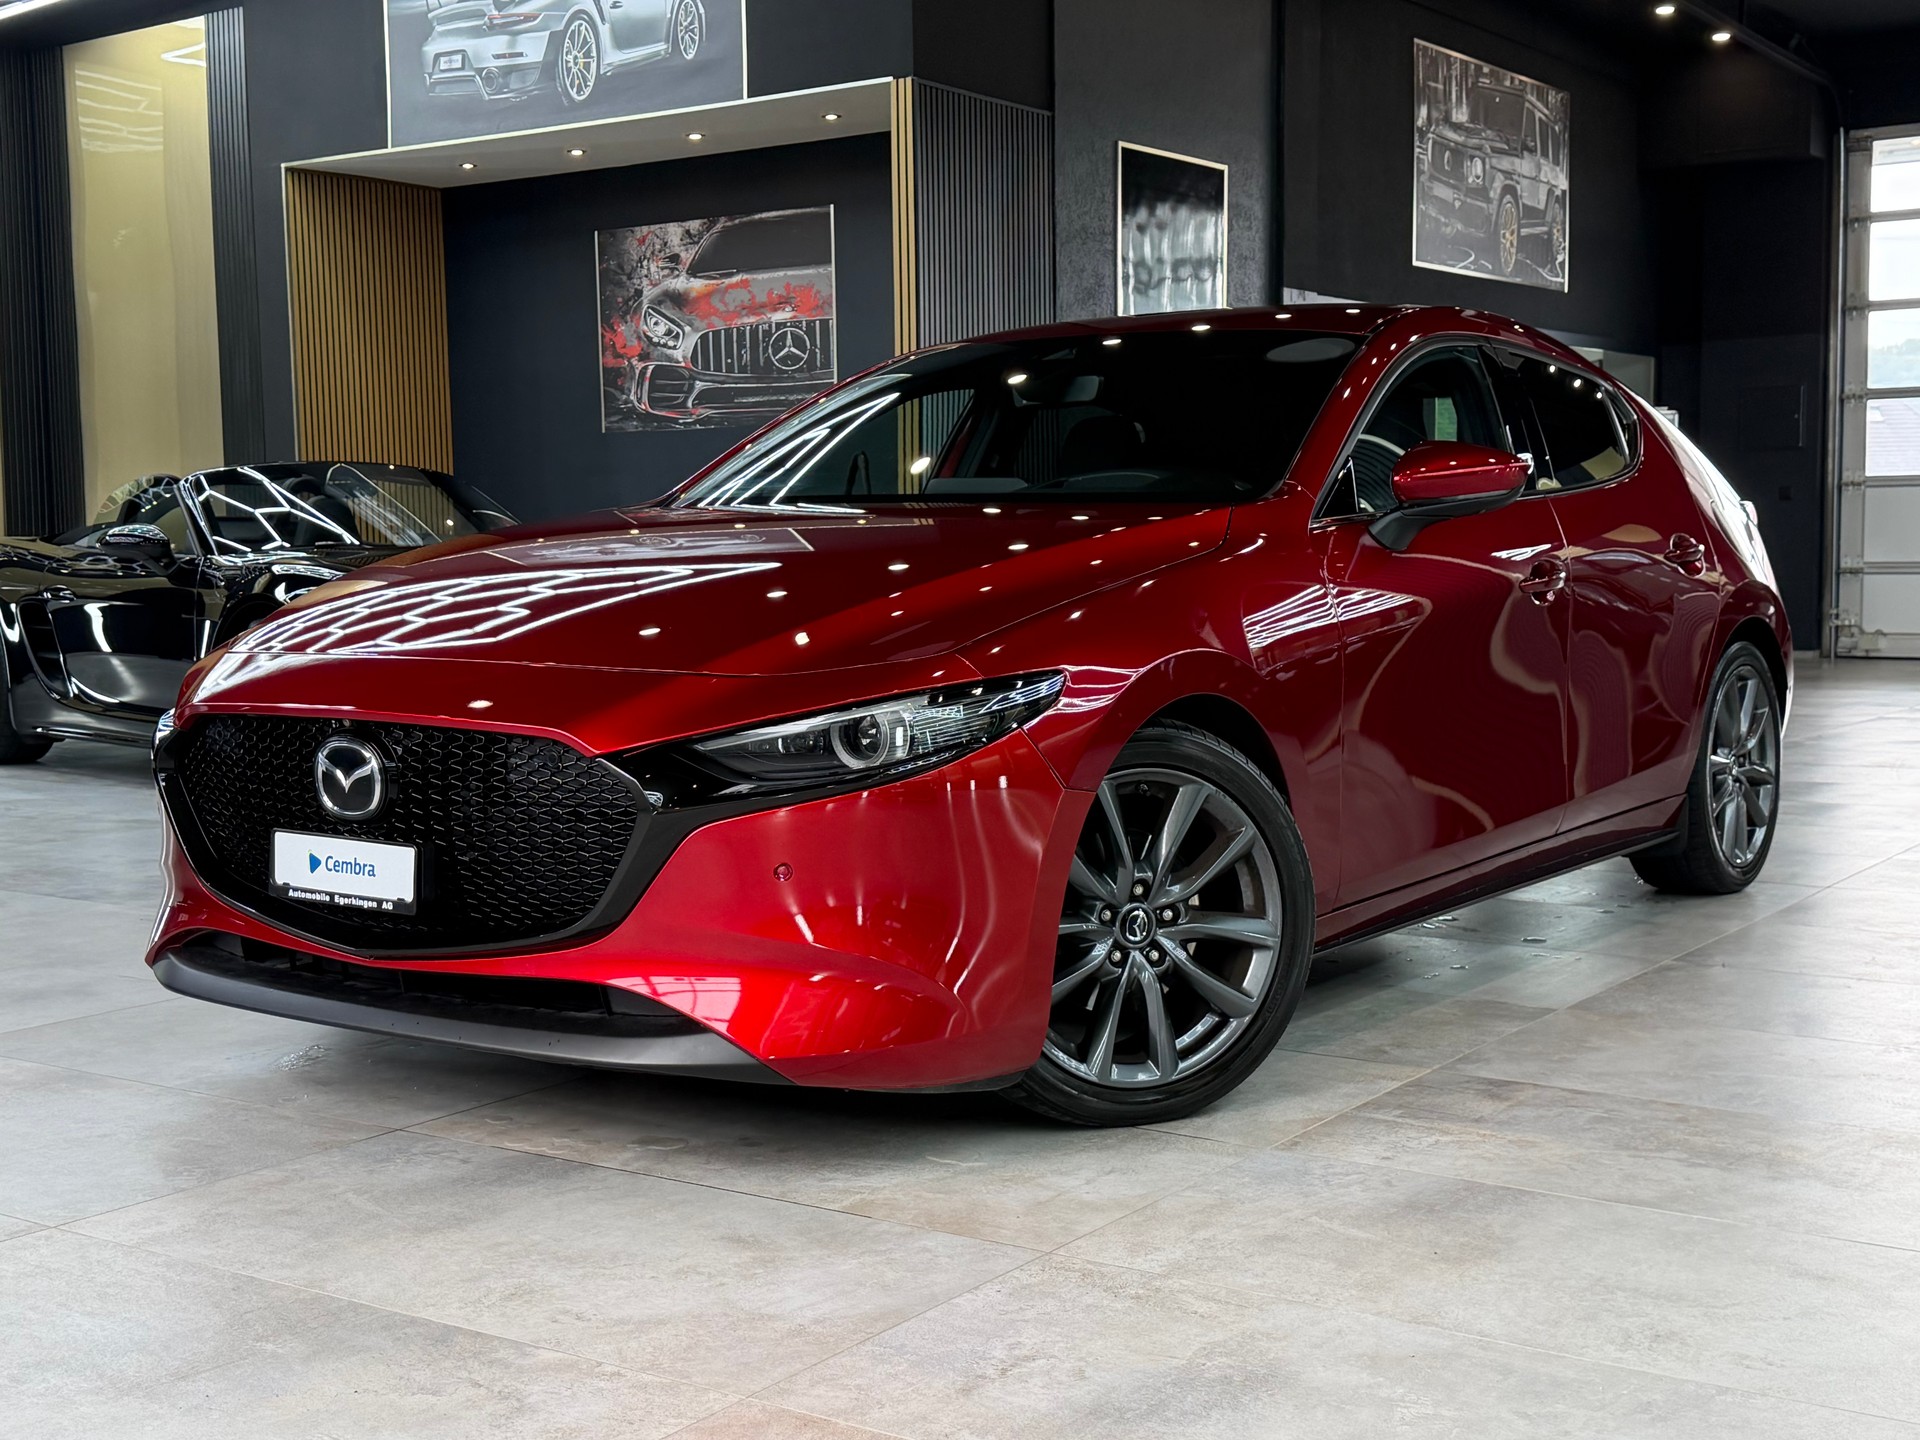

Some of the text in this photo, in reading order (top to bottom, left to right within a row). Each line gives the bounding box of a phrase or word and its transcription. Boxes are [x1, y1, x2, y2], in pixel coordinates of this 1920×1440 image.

[325, 855, 376, 878] Cembra
[288, 888, 394, 910] Automobile Egerkingen AG
